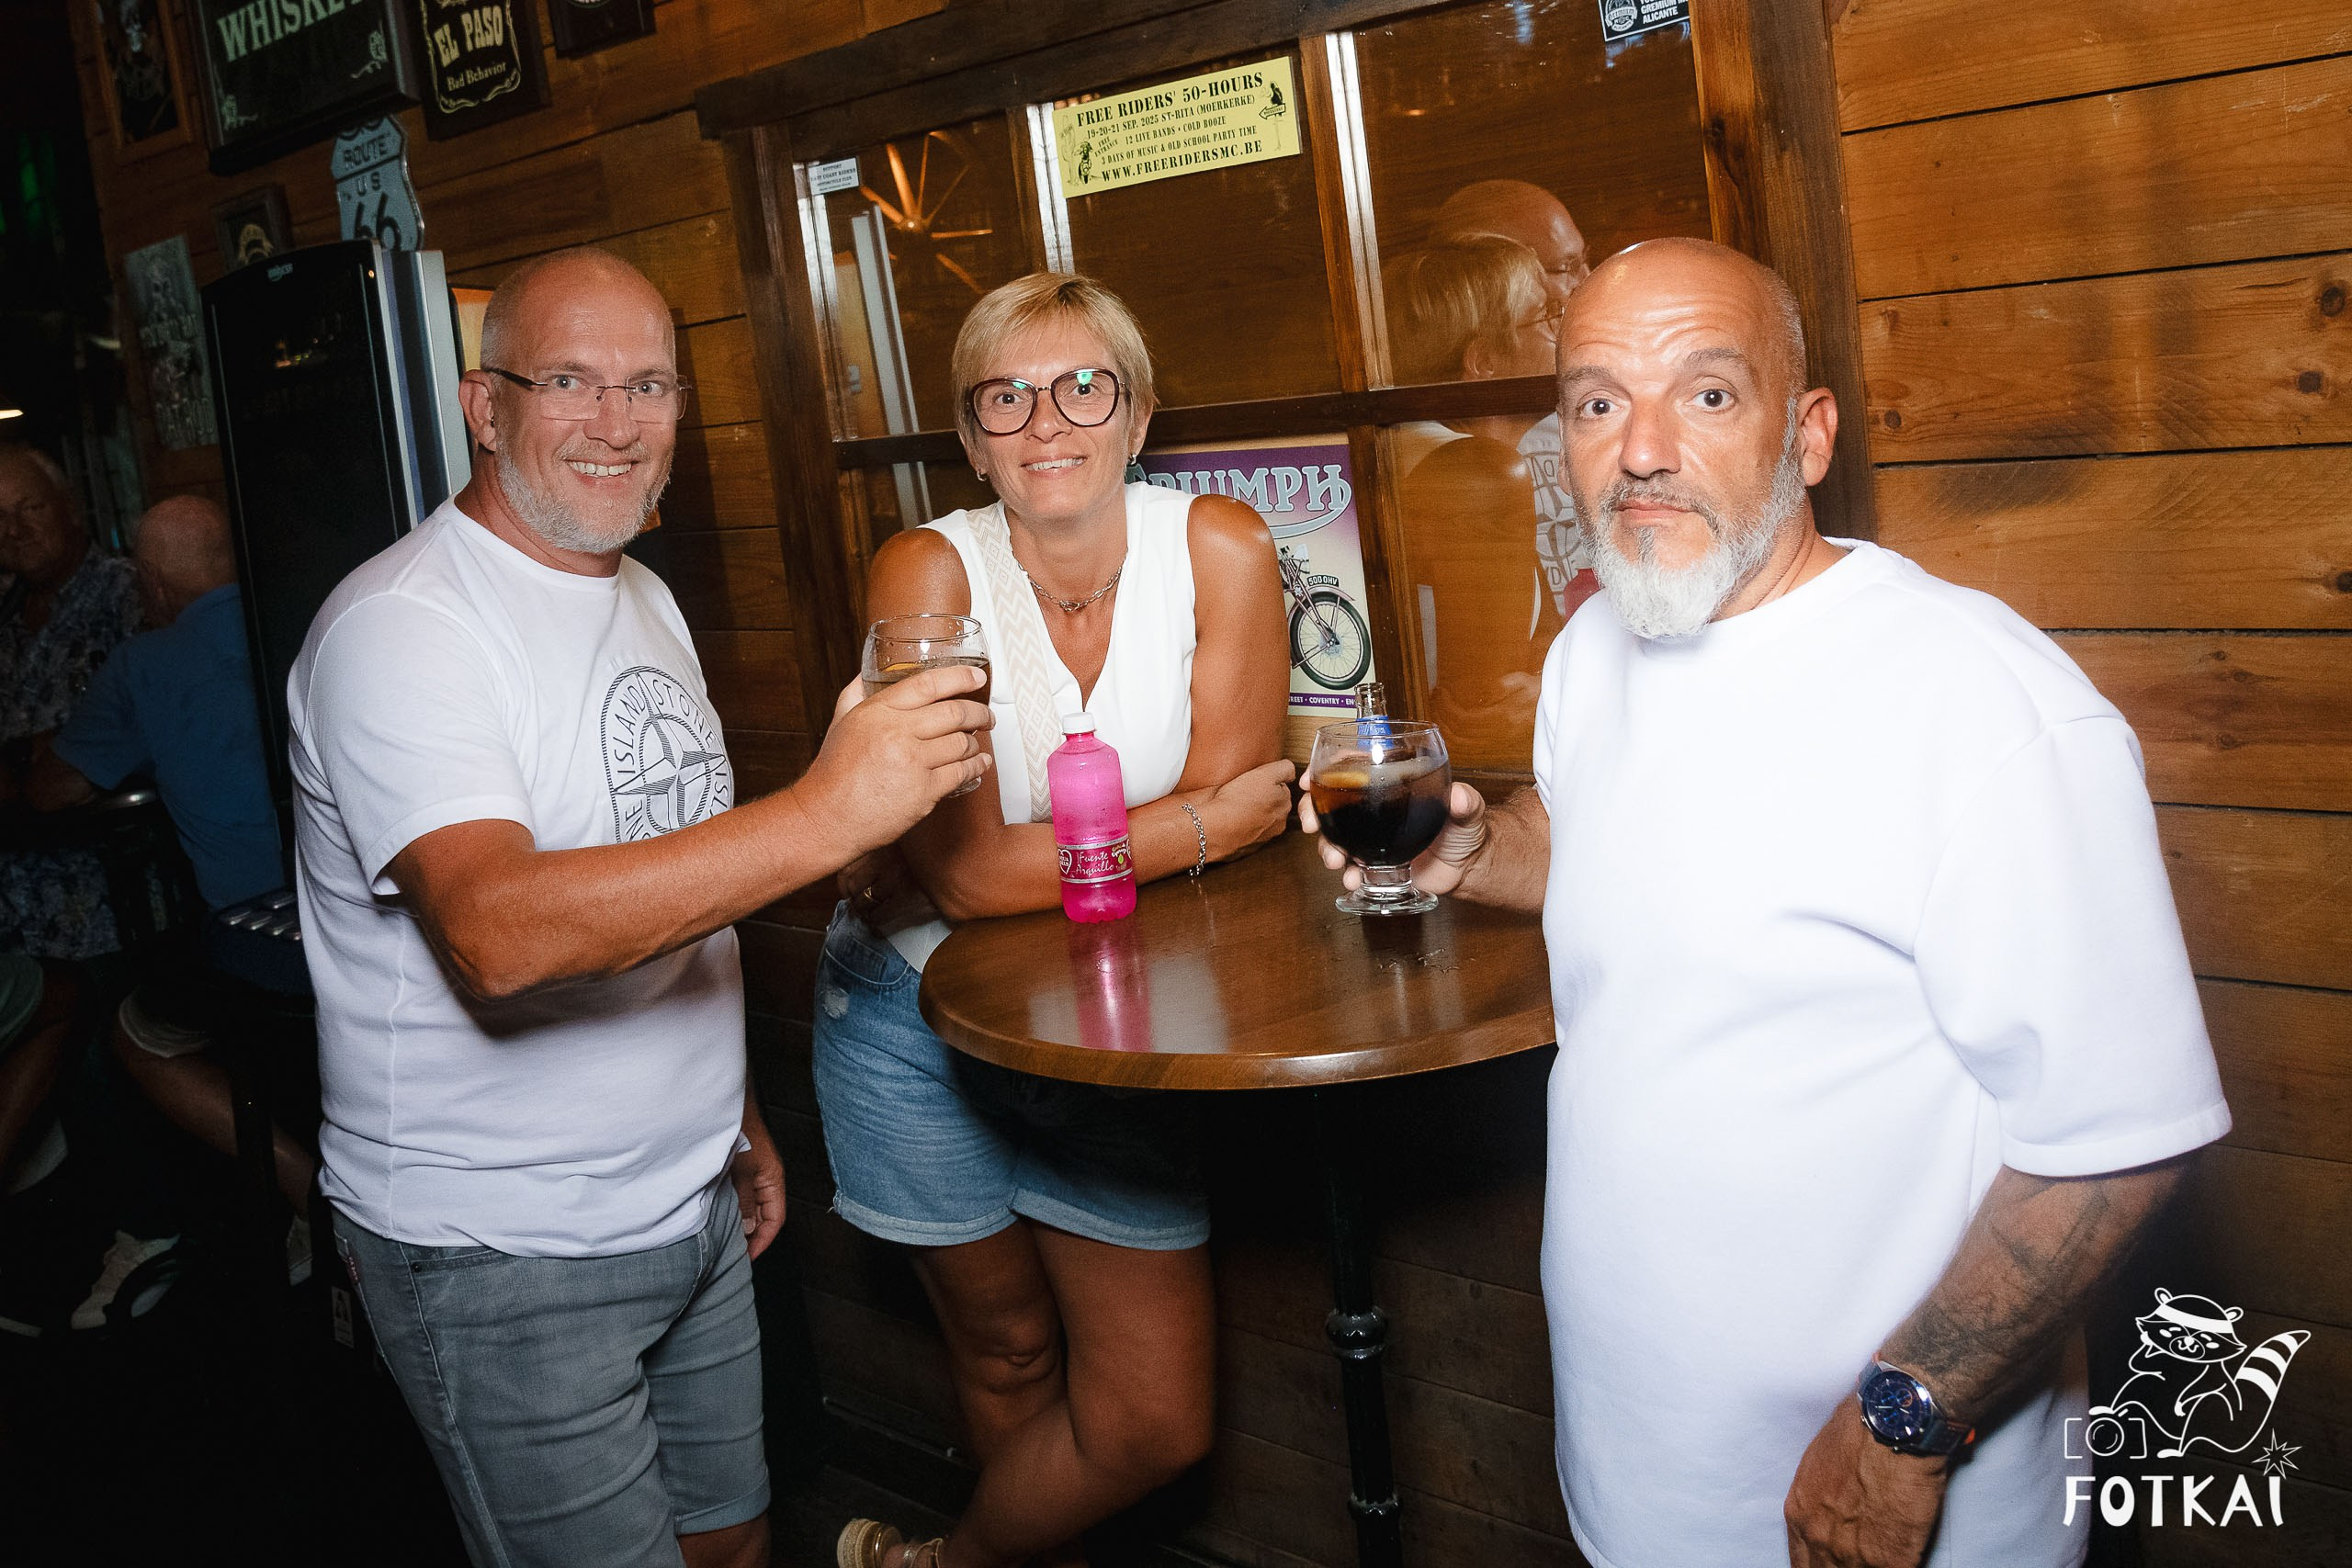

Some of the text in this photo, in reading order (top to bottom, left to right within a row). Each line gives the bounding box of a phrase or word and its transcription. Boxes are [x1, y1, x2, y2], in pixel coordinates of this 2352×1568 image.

[217, 0, 362, 62] WHISK
[434, 5, 503, 68] EL PASO
[1643, 6, 1679, 25] ALICANTE
[447, 62, 506, 91] Bad Behavior
[1077, 72, 1263, 128] FREE RIDERS' 50-HOURS
[1087, 94, 1256, 140] 19-20-21 SEP. 2025 ST-RITA (MOERKERKE)
[344, 137, 387, 166] ROUTE
[1102, 125, 1257, 164] 3 DAYS OF MUSIC & OLD SCHOOL PARTY TIME
[1125, 116, 1227, 145] 12 LIVE BANDS COLD BOOZE
[1102, 140, 1262, 183] WWW.FREERIDERSMC.BE
[357, 172, 380, 197] US
[355, 191, 401, 251] 66
[1125, 463, 1352, 513] IUMPH
[1289, 695, 1304, 704] REET
[1309, 696, 1340, 705] COVENTRY
[613, 684, 646, 773] ISLAND
[652, 679, 716, 749] STONE
[709, 771, 729, 818] ISL
